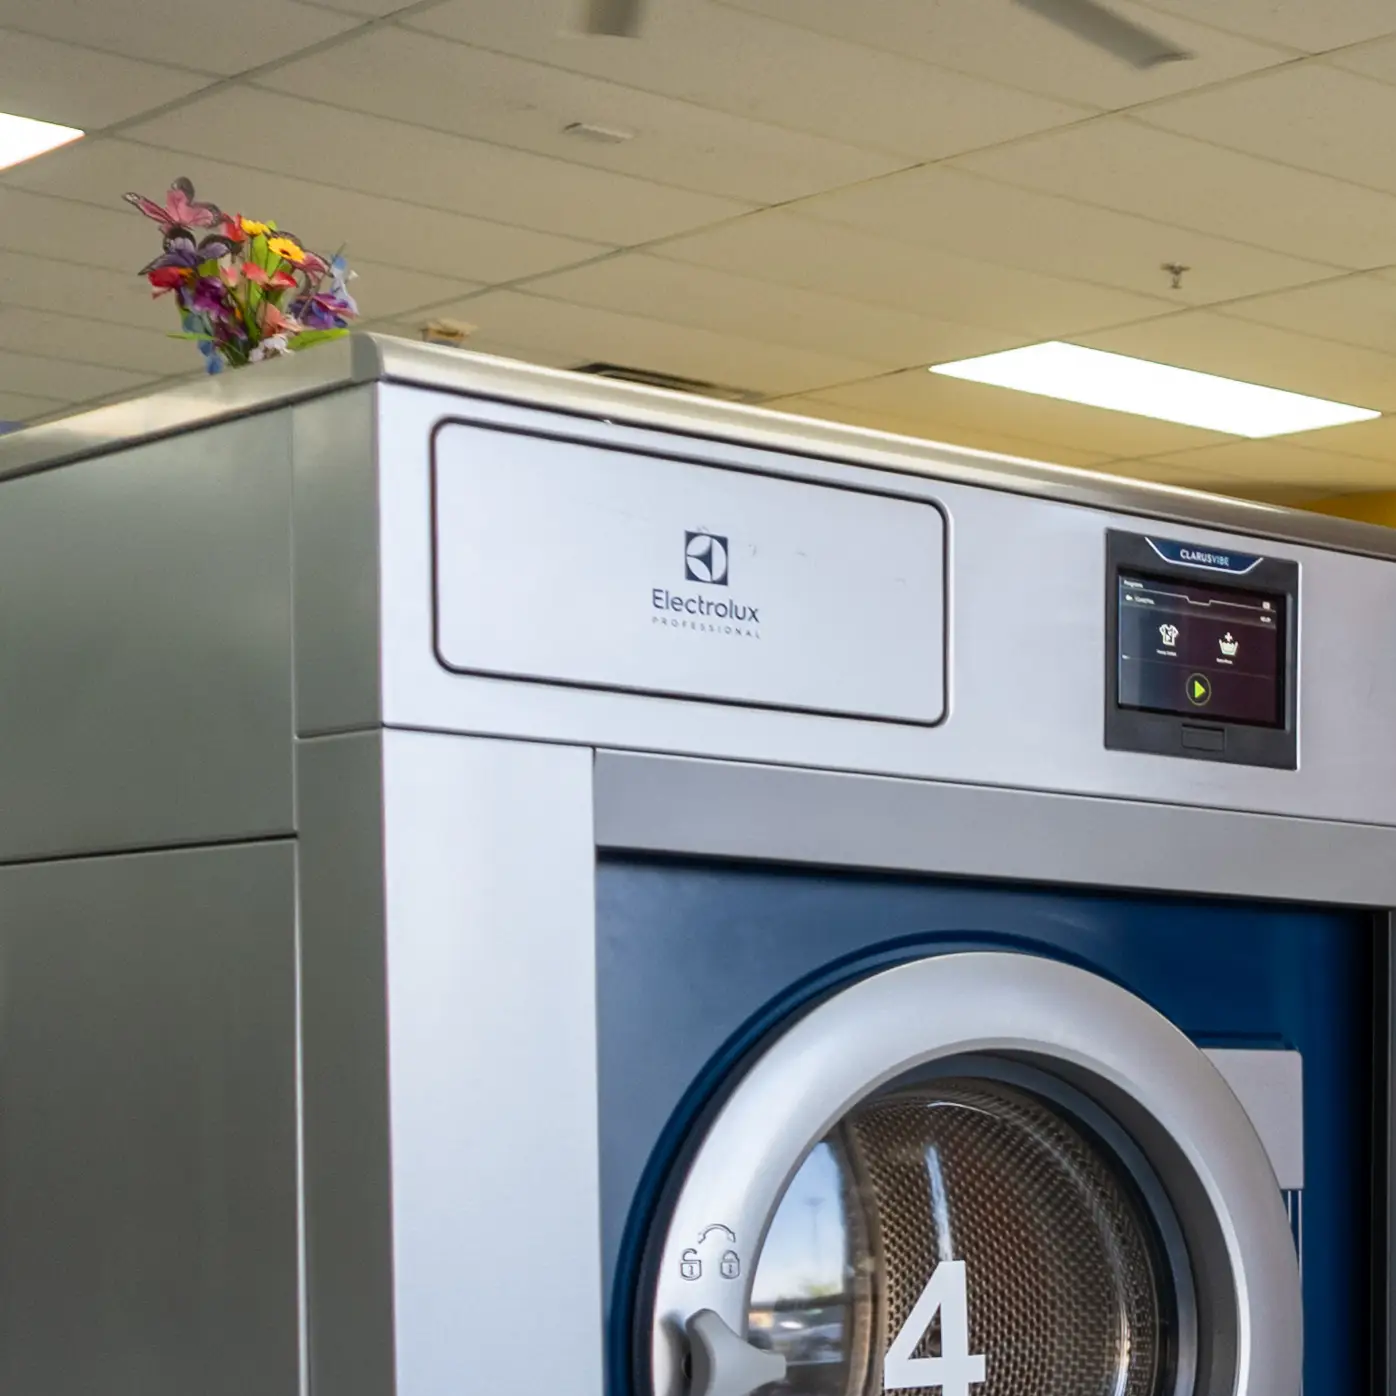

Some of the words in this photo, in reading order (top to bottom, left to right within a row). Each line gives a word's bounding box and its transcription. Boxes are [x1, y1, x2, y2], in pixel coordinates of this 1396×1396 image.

[1180, 548, 1230, 567] CLARUSVIBE
[652, 587, 760, 623] Electrolux
[651, 616, 761, 639] PROFESSIONAL
